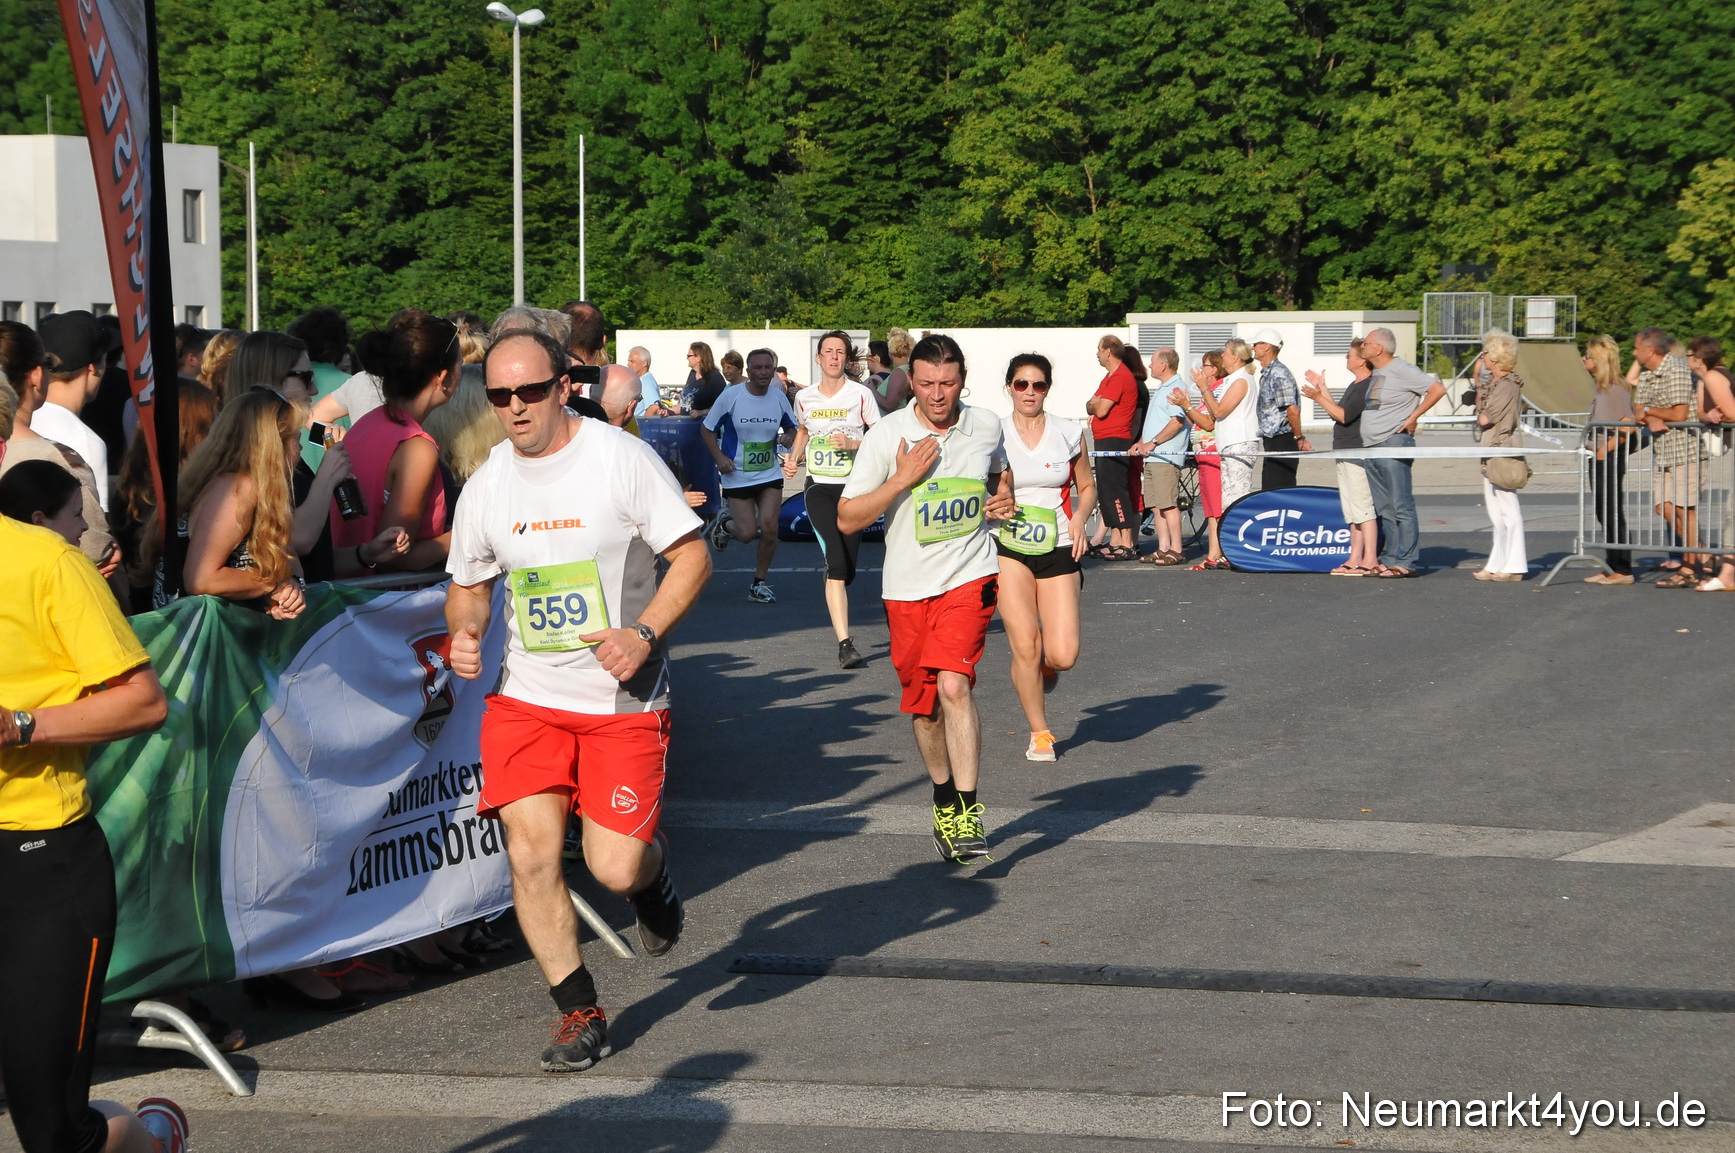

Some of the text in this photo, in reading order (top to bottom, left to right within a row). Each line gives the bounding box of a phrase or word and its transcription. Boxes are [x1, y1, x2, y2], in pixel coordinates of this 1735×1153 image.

[811, 409, 844, 419] ONLINE
[748, 451, 771, 465] 200
[813, 450, 845, 467] 912
[918, 496, 980, 528] 1400
[531, 519, 586, 532] KLEBL
[1010, 521, 1047, 543] 120
[528, 592, 588, 631] 559
